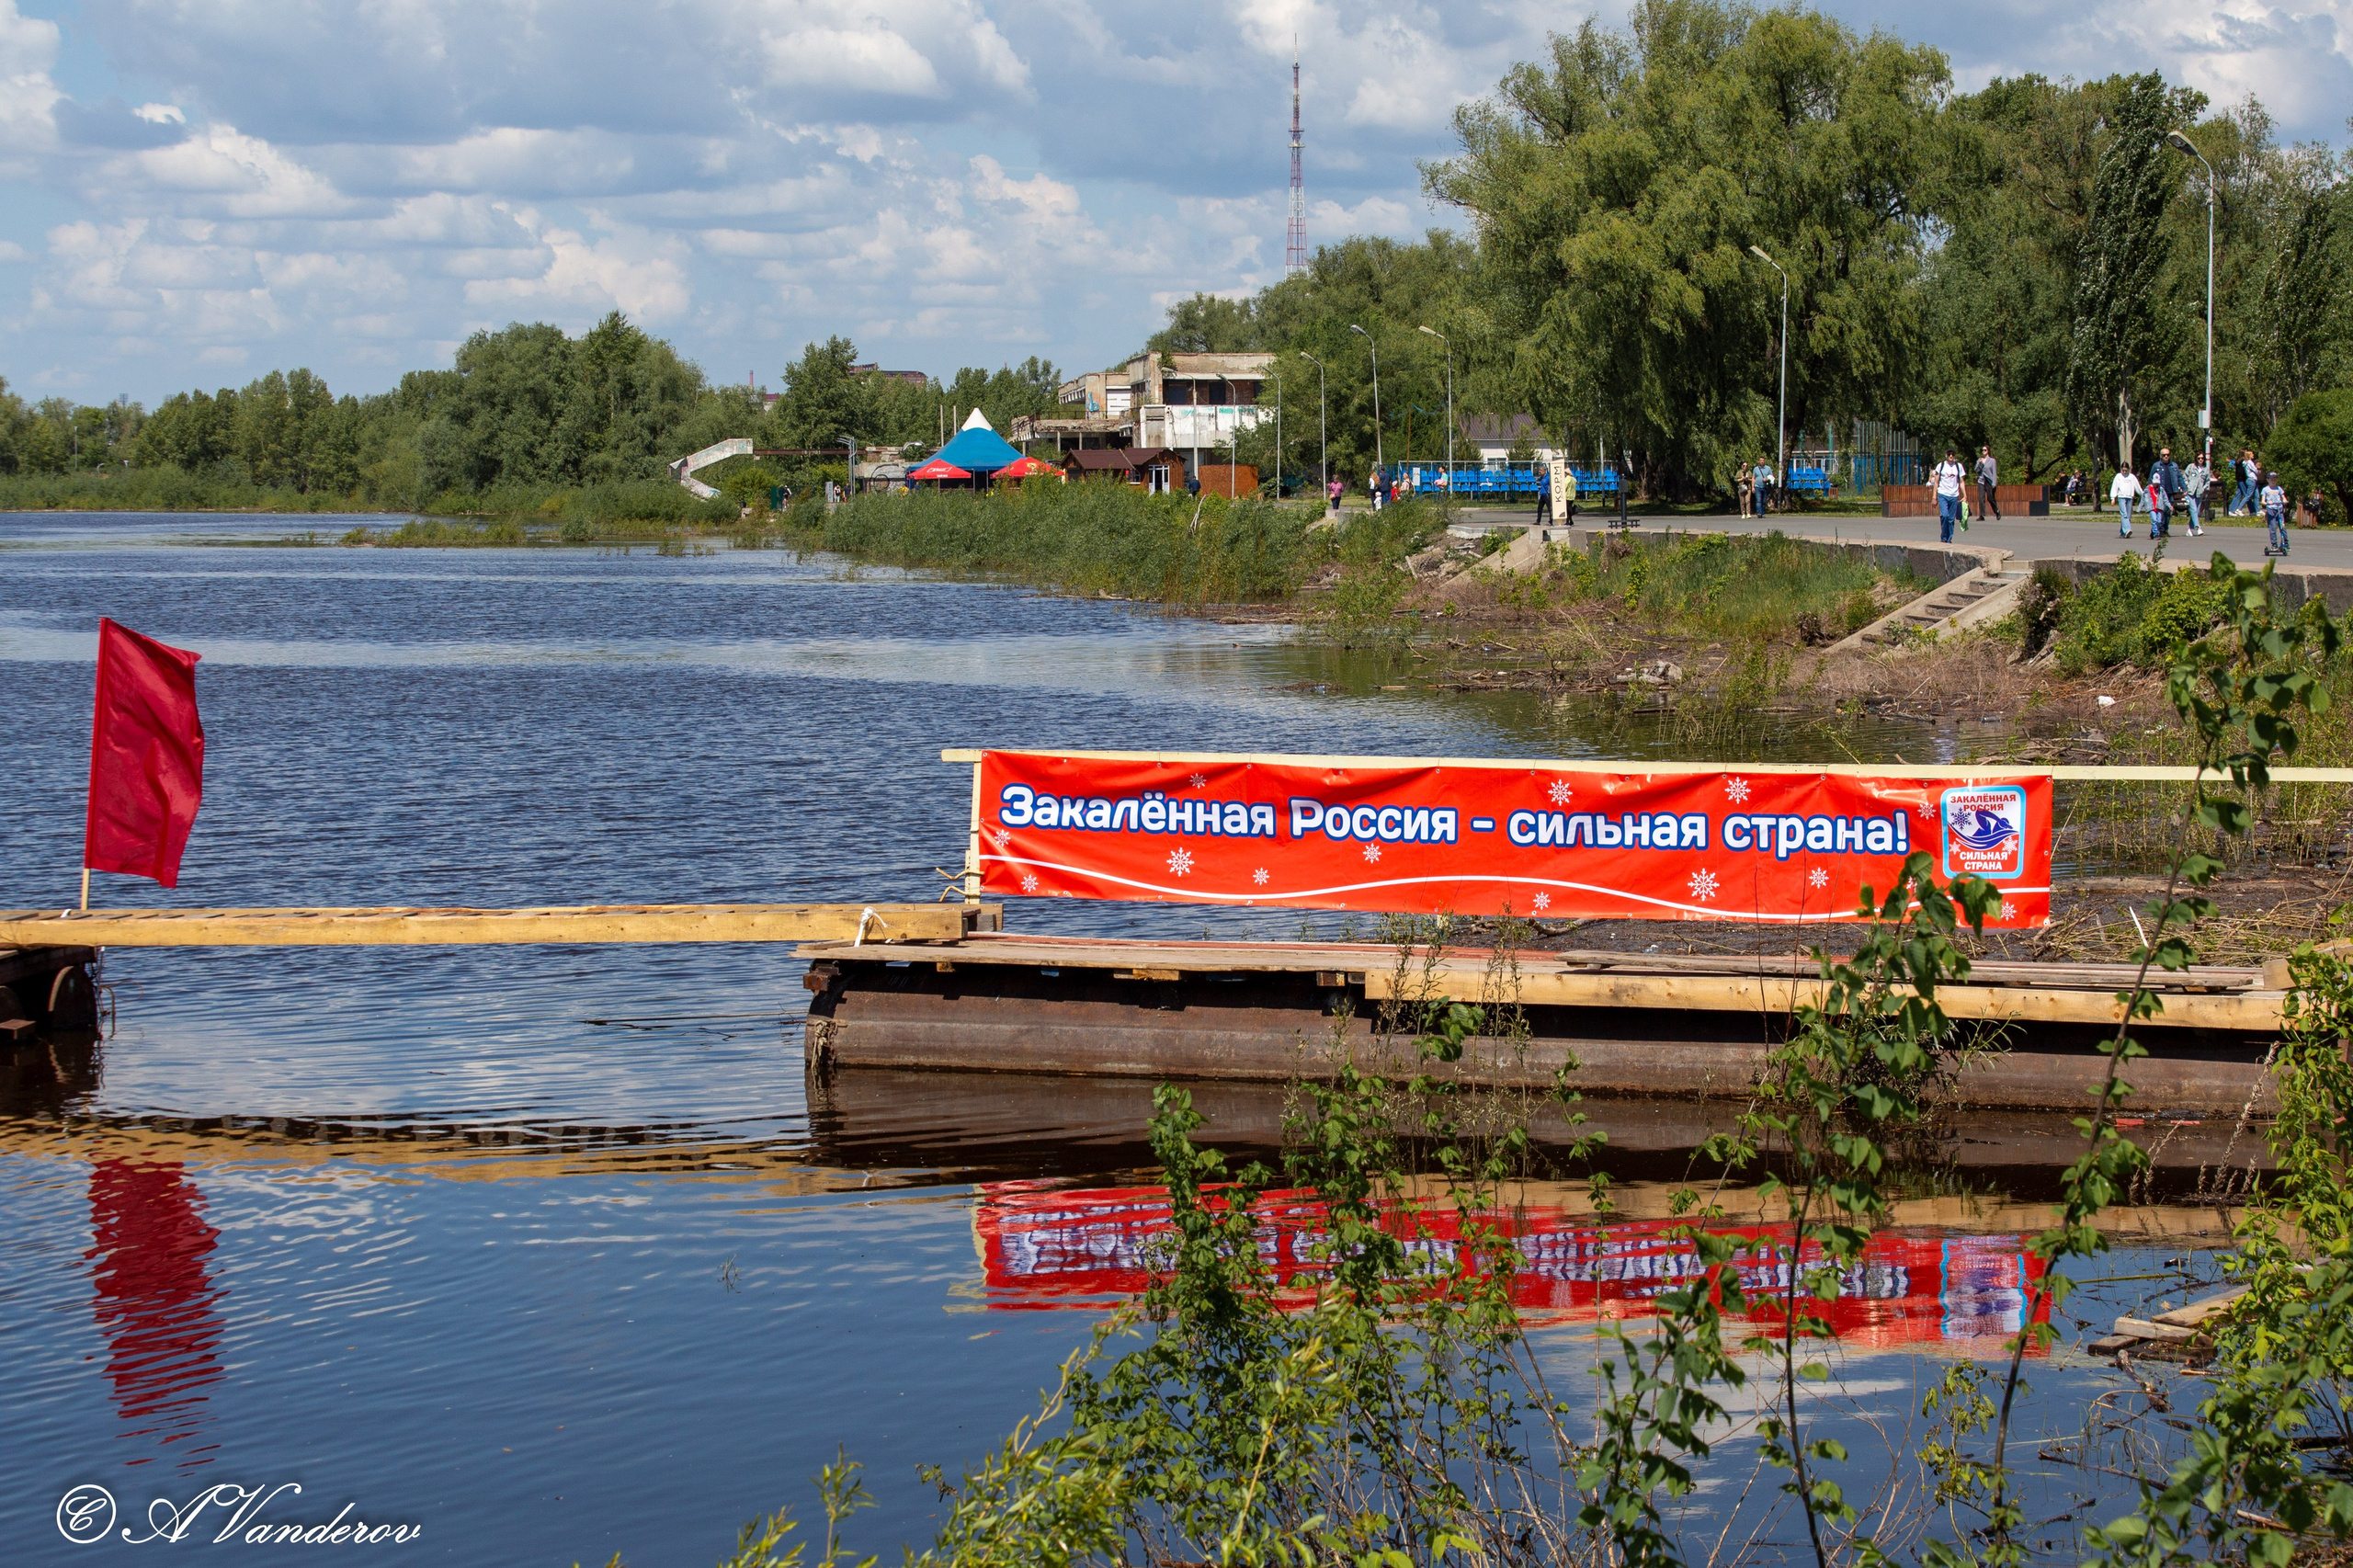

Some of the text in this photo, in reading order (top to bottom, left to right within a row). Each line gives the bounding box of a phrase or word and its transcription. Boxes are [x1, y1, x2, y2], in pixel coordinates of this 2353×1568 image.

[1950, 793, 2017, 804] ЗАКАЛЁННАЯ
[1963, 803, 2005, 812] РОССИЯ
[1000, 783, 1276, 837] Закалённая
[1290, 797, 1459, 844] Россия
[1507, 809, 1709, 850] сильная
[1722, 809, 1911, 861] страна!
[1959, 851, 2008, 860] СИЛЬНАЯ
[1964, 861, 2003, 870] СТРАНА
